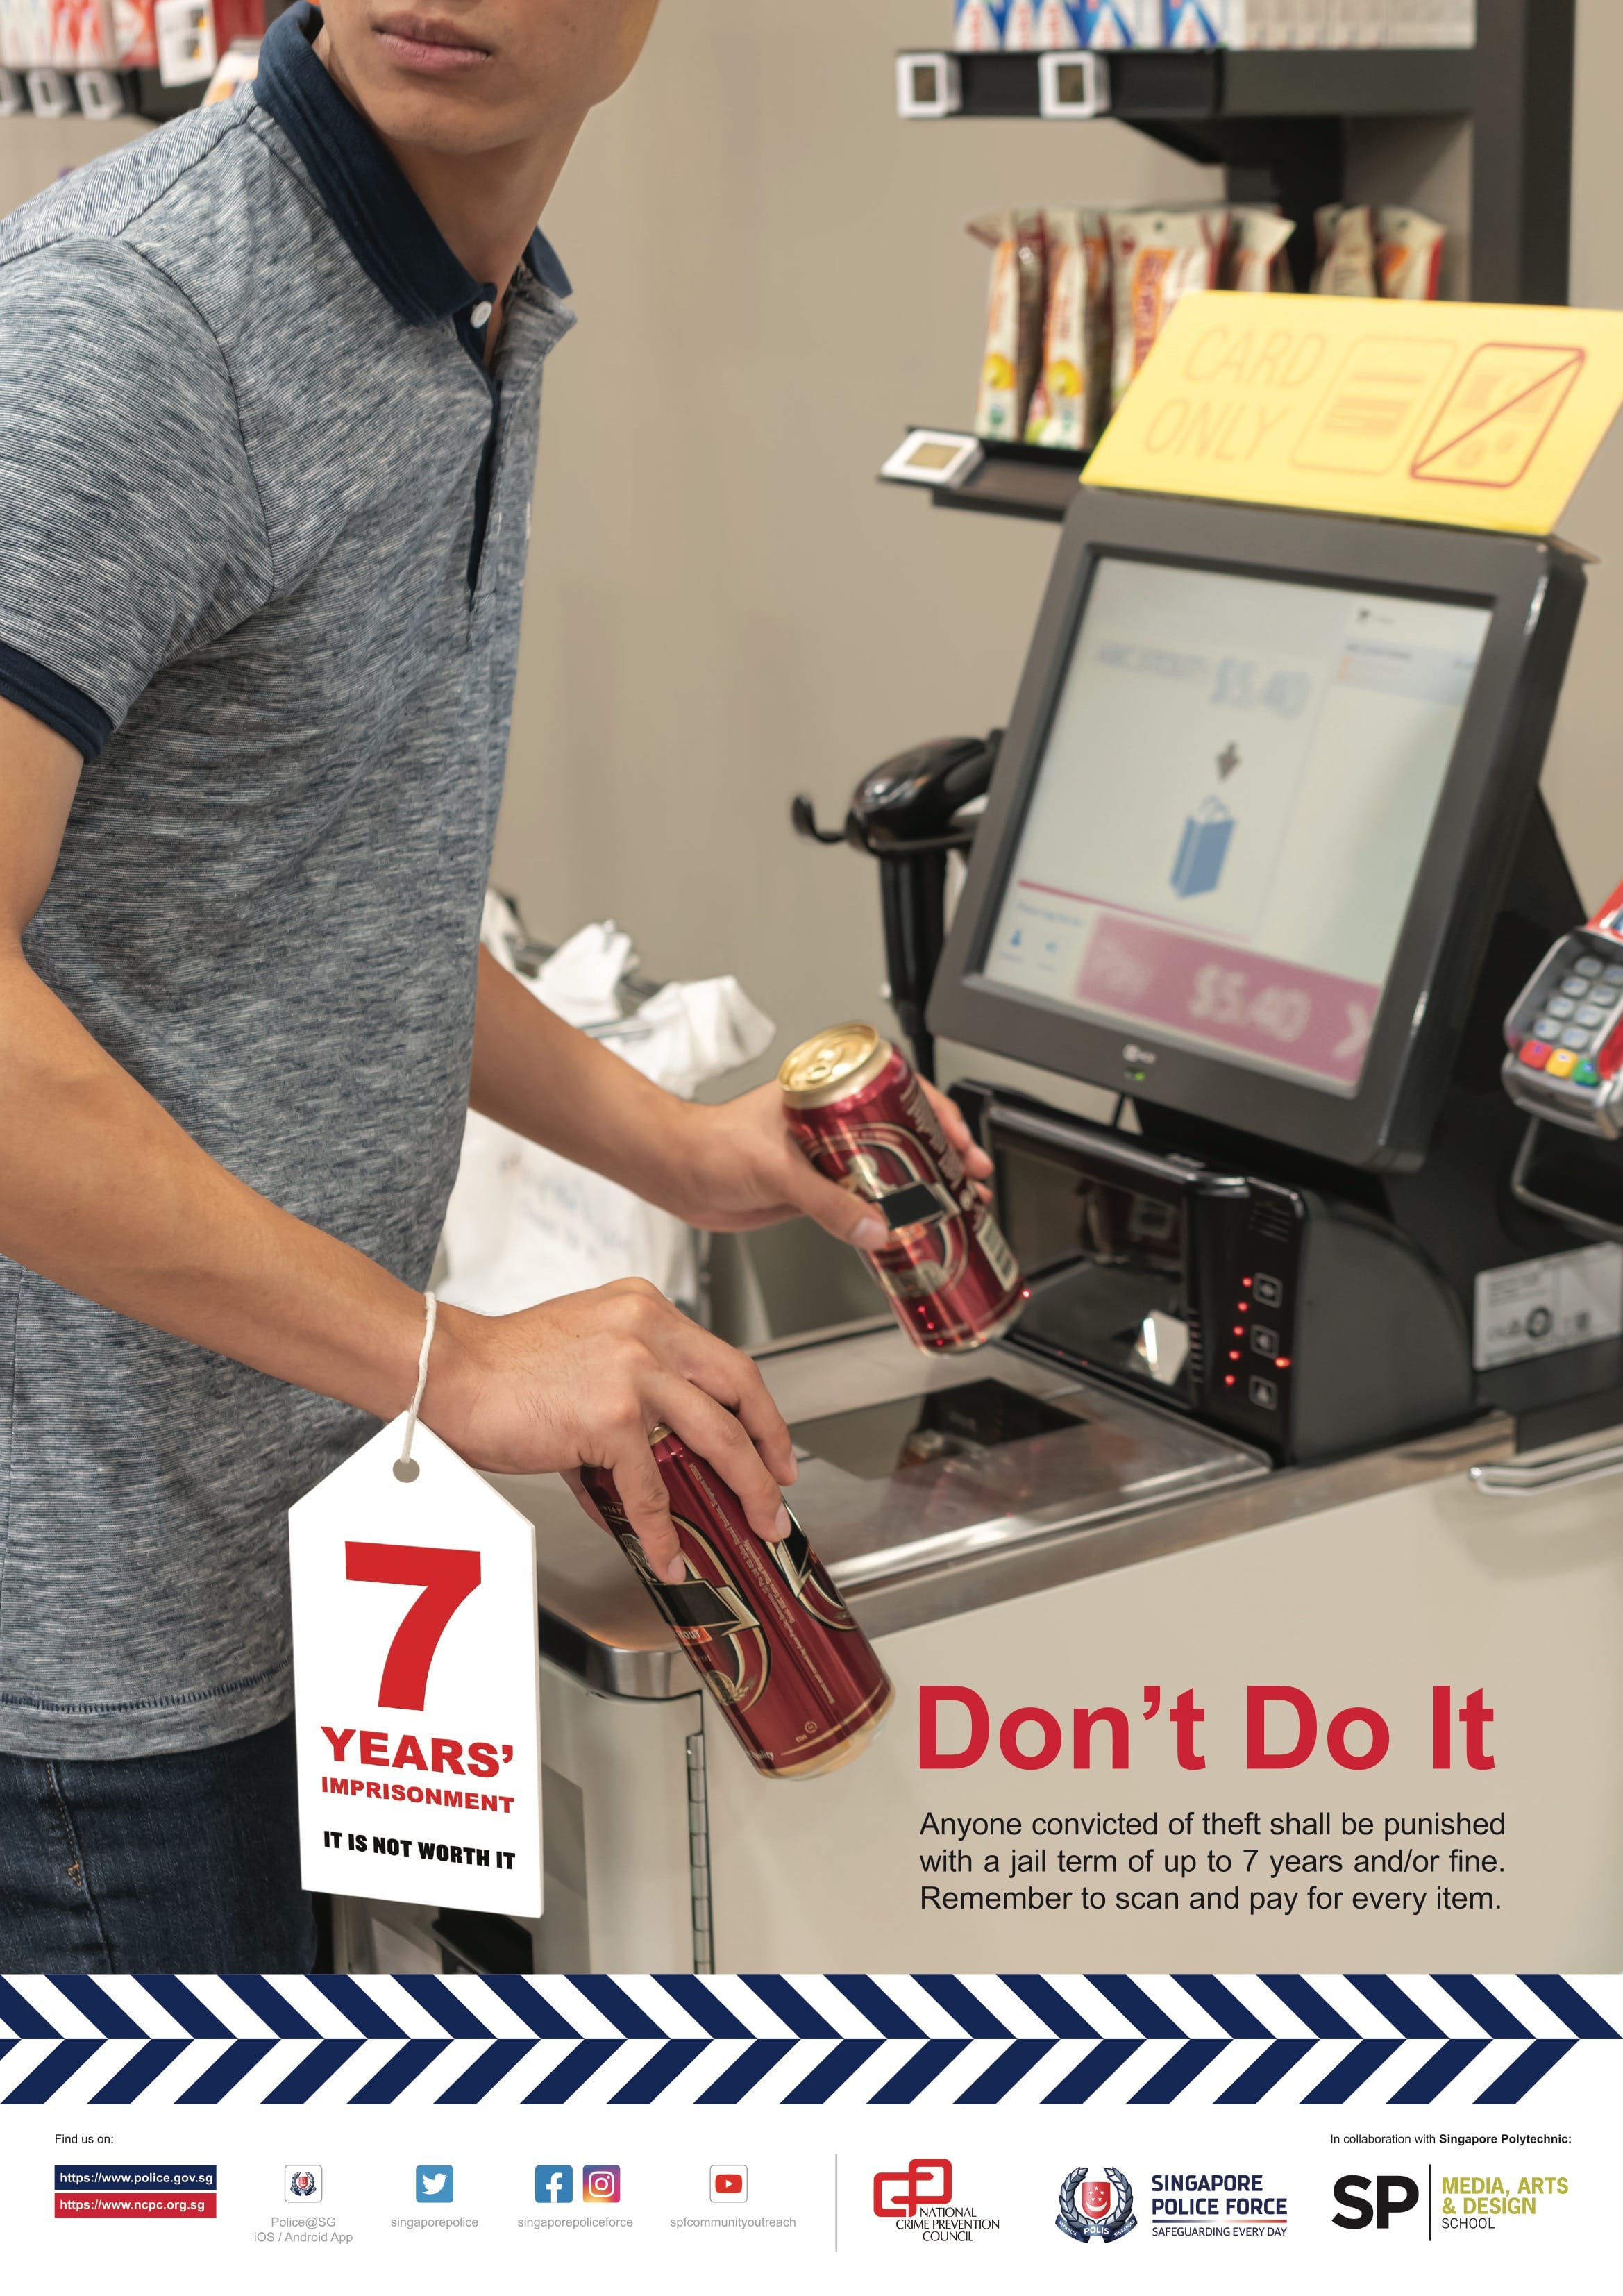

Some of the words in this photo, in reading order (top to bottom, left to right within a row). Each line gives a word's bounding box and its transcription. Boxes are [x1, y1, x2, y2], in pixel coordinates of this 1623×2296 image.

[1185, 324, 1327, 388] CARD
[1145, 398, 1292, 462] ONLY
[1188, 962, 1311, 1042] $5.40
[344, 1541, 481, 1711] 7
[321, 1726, 513, 1778] YEARS’
[321, 1776, 514, 1813] IMPRISONMENT
[323, 1831, 342, 1849] IT
[348, 1834, 367, 1852] IS
[373, 1836, 412, 1857] NOT
[417, 1841, 490, 1867] WORTH
[496, 1851, 515, 1870] IT
